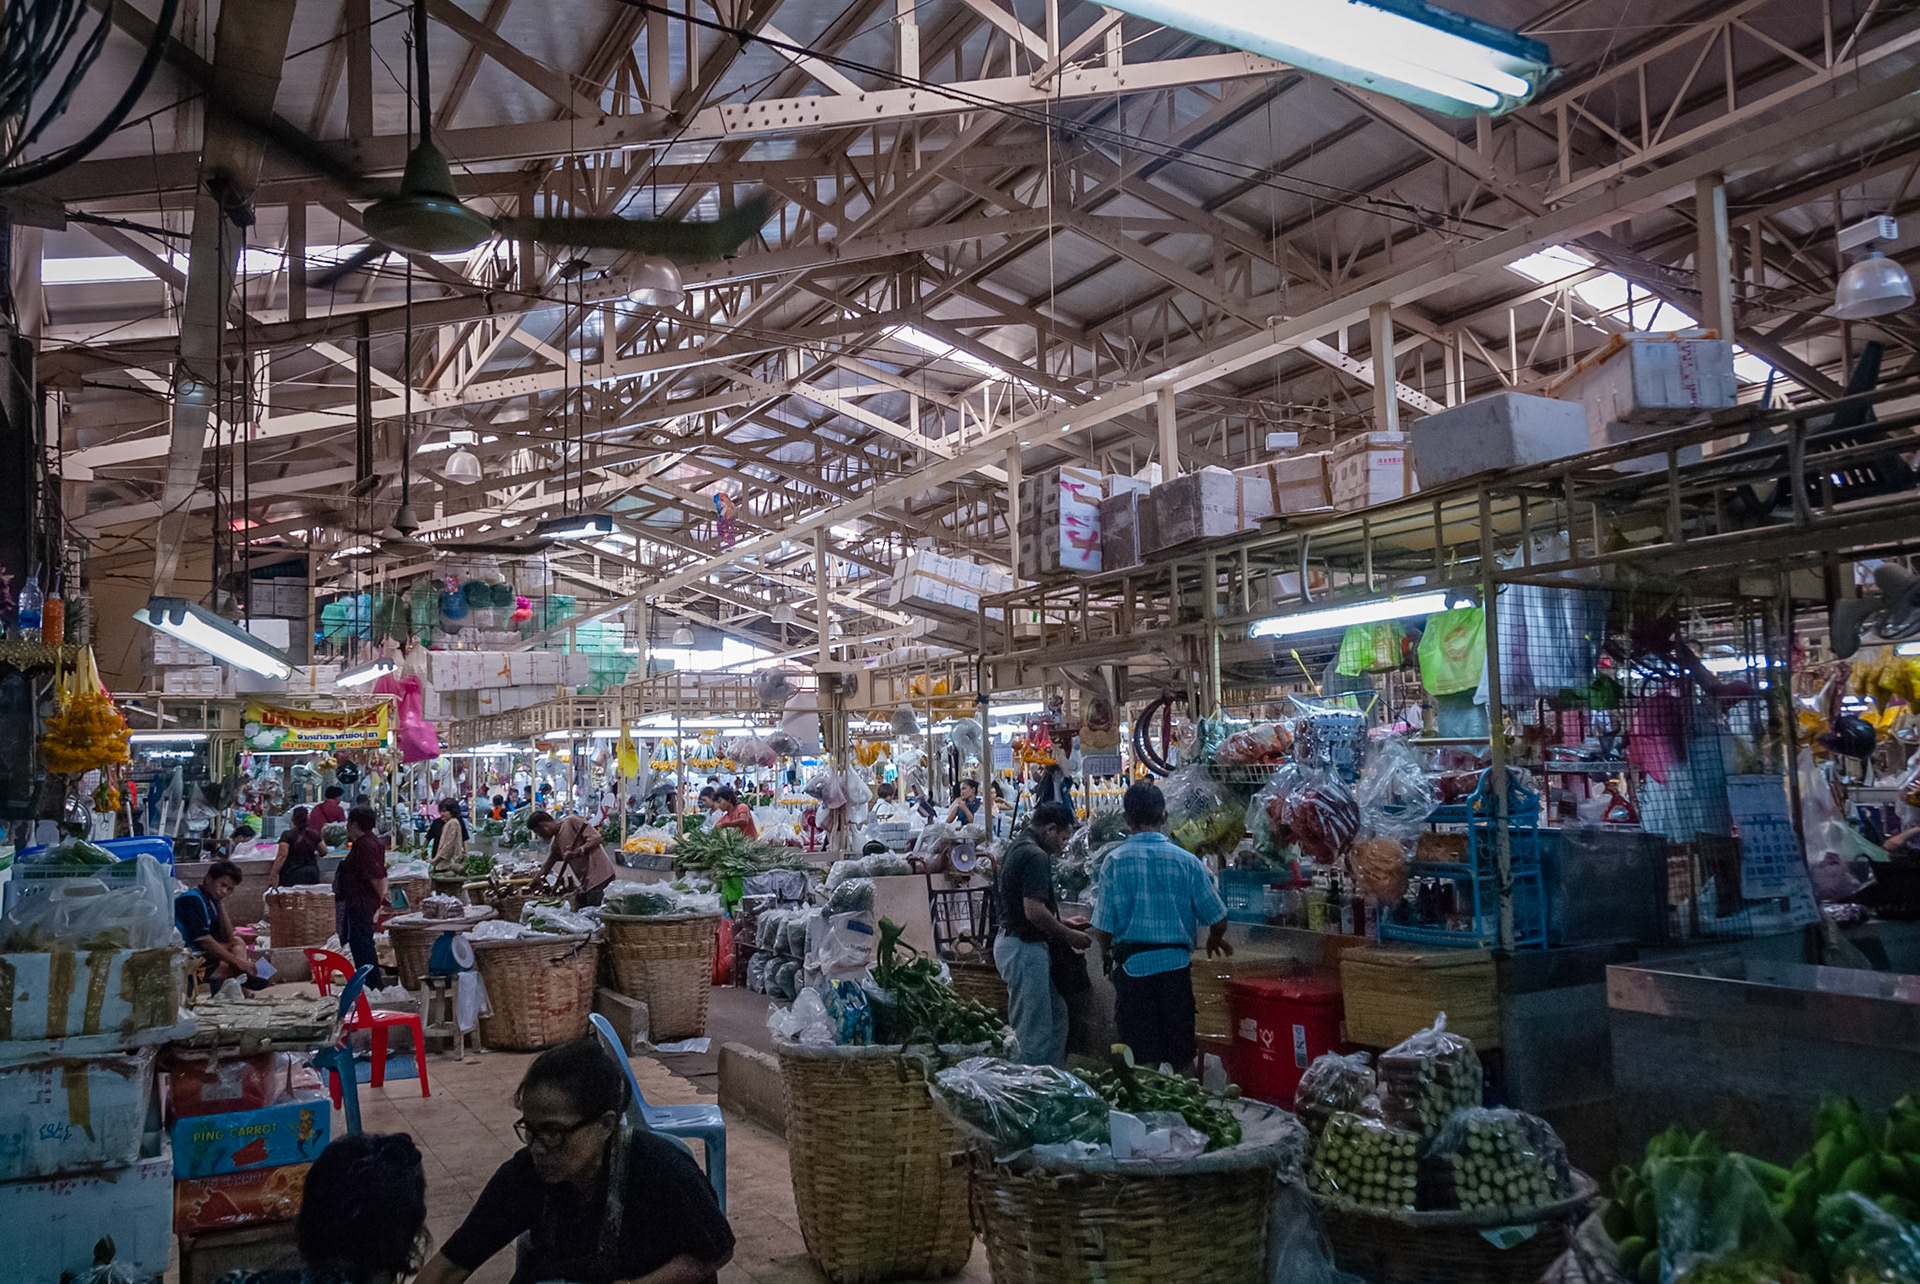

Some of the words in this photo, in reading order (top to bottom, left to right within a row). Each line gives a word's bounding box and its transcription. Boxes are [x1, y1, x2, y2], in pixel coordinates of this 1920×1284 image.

[297, 731, 378, 740] จำหน่ายราคาย่อมยา
[193, 1130, 224, 1142] PING
[229, 1123, 277, 1138] CARROT
